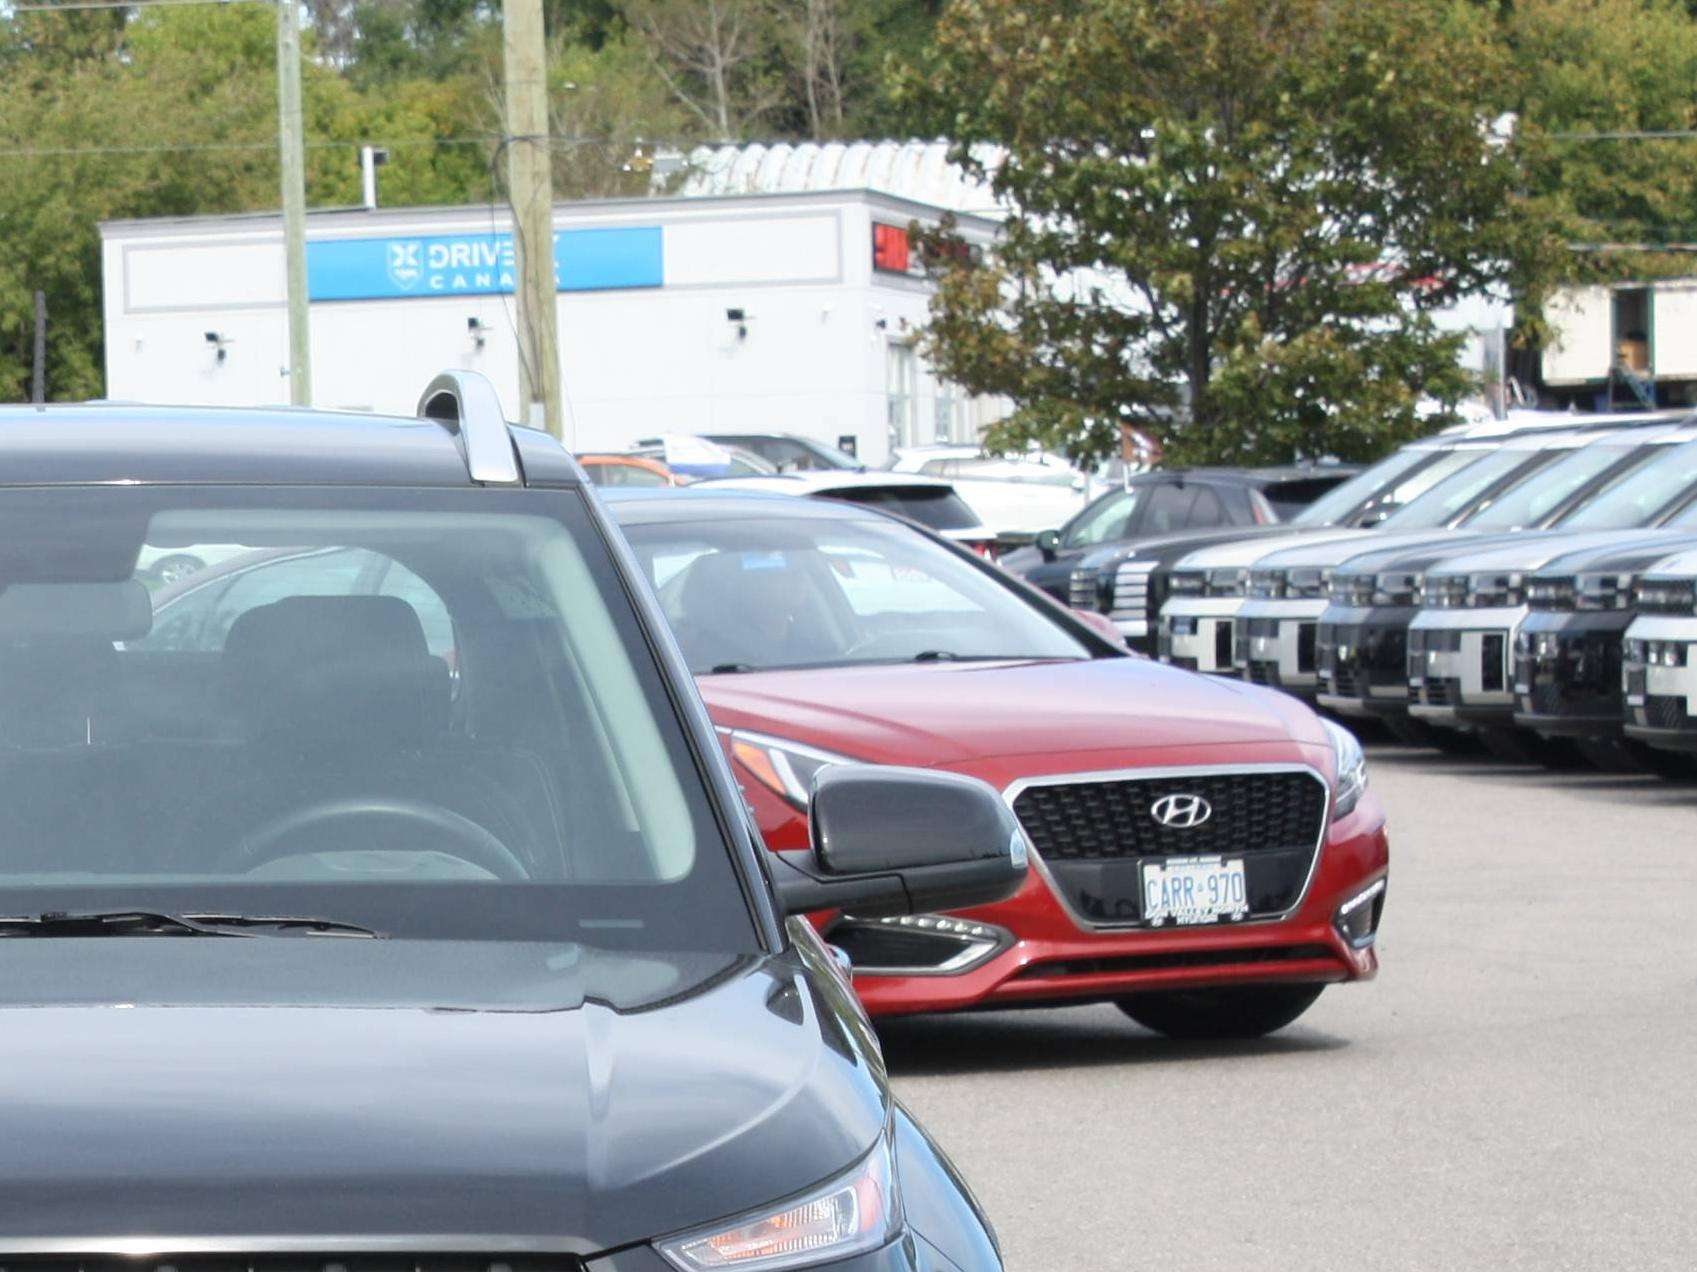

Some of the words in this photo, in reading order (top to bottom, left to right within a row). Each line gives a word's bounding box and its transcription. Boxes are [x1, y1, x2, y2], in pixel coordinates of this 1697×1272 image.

[429, 273, 560, 290] CANA
[1146, 875, 1195, 911] CARR
[1207, 872, 1245, 905] 970
